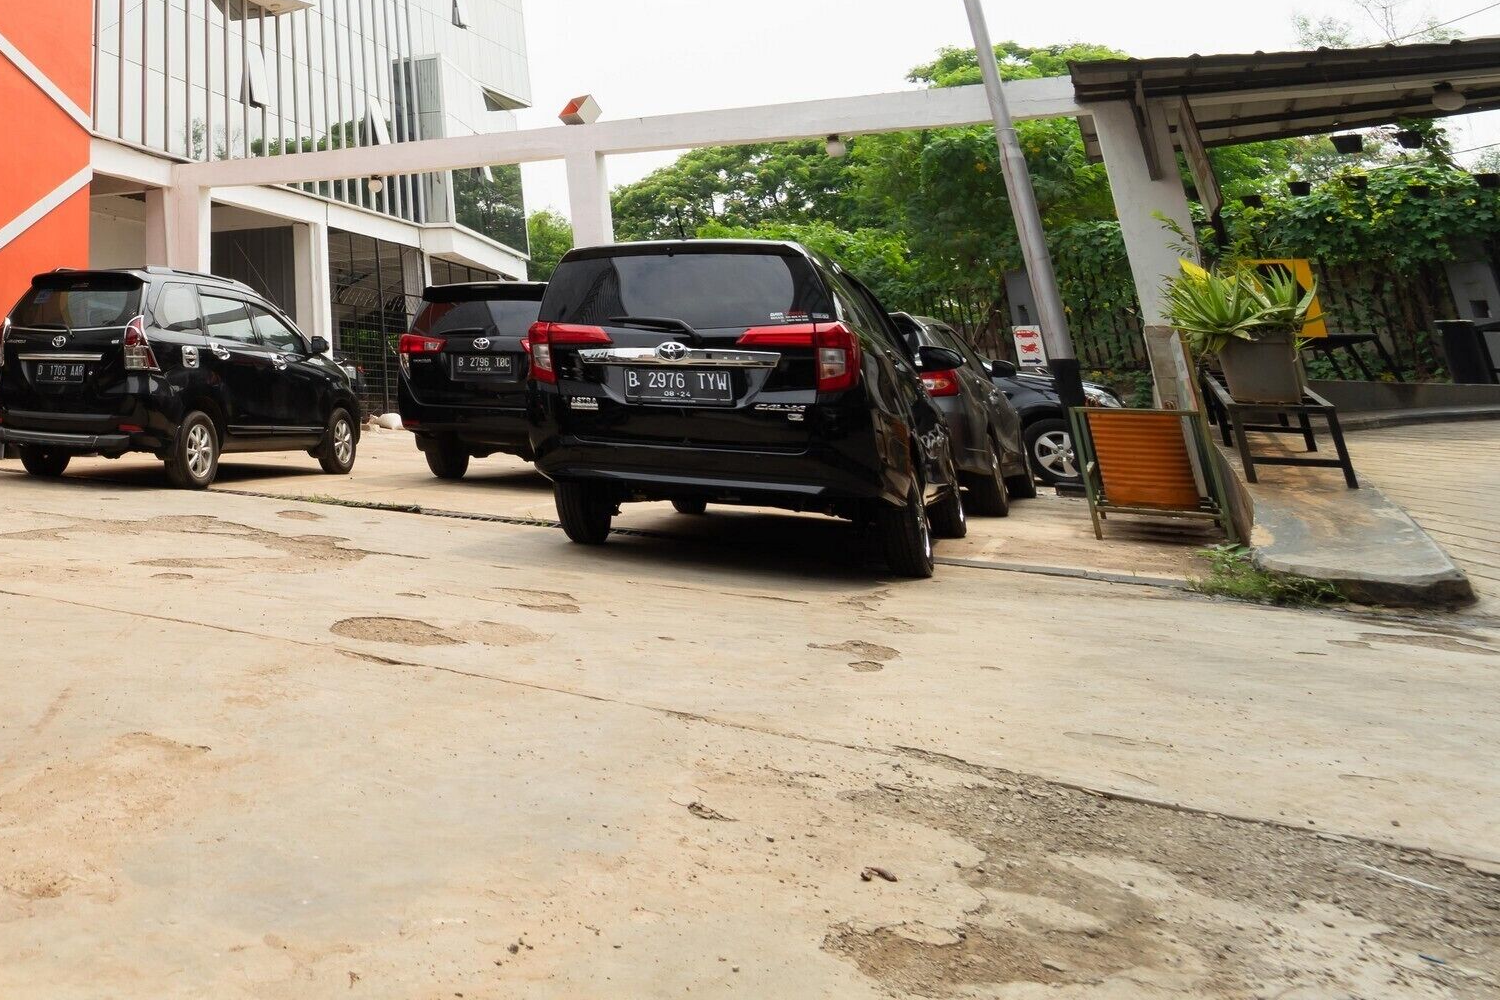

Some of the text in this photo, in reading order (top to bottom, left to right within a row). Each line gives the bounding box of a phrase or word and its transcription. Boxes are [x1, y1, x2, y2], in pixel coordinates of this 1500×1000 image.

[458, 356, 464, 367] B
[470, 356, 490, 367] 2796
[50, 365, 67, 376] 1703
[628, 371, 728, 391] B 2976 TYW
